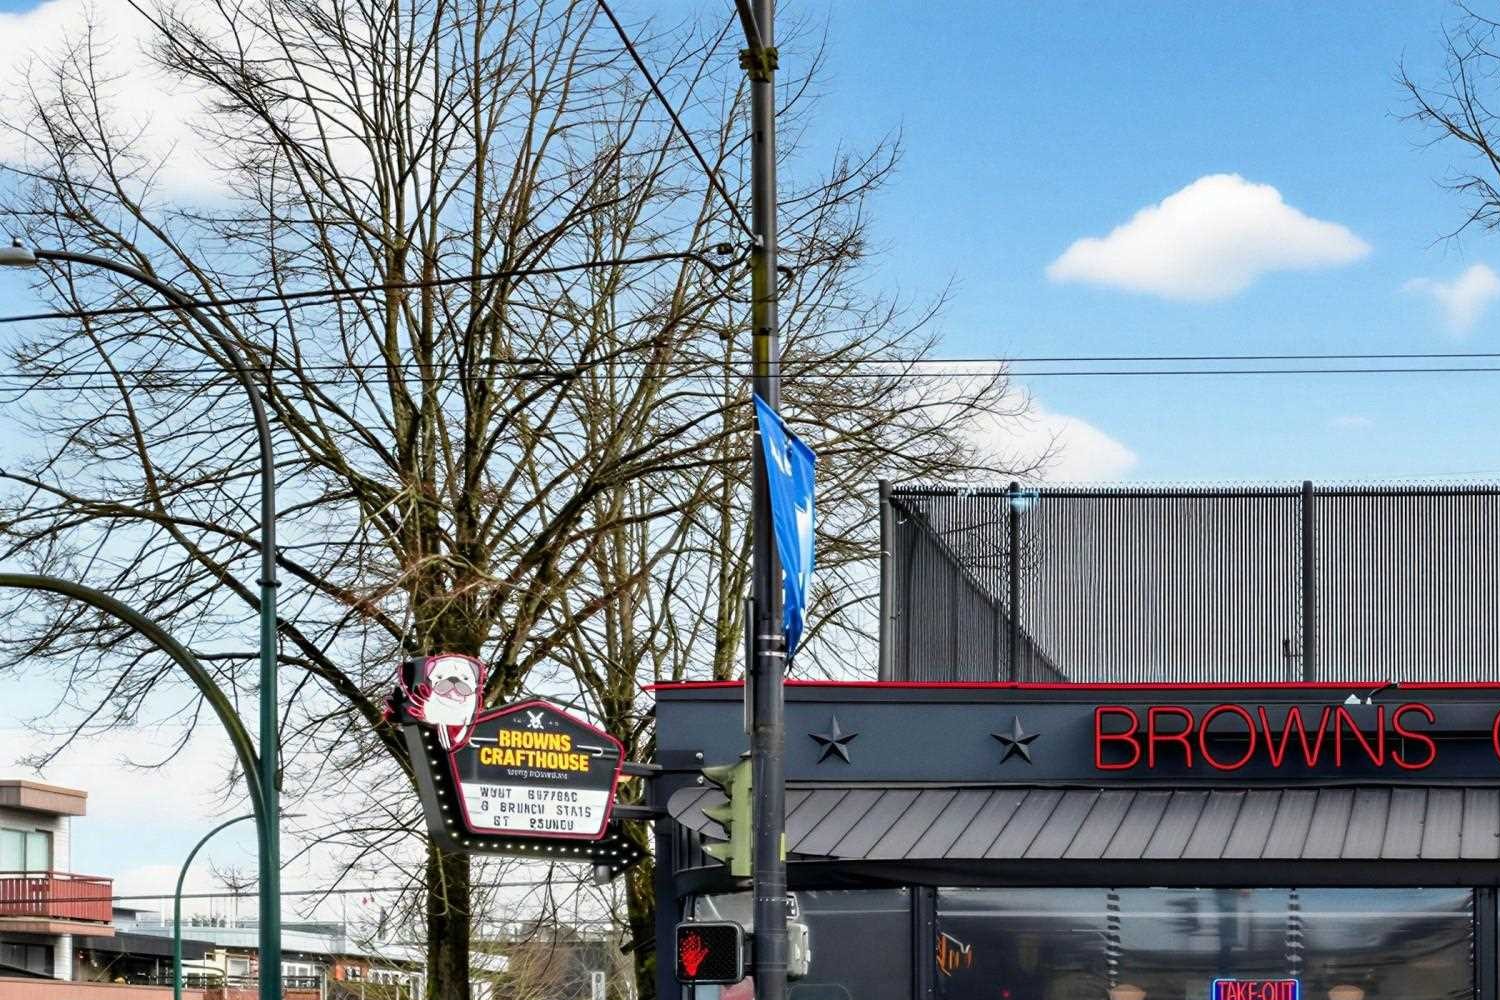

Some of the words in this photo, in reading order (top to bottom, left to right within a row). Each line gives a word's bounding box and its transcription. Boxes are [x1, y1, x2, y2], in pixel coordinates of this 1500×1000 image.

[499, 729, 572, 752] BROWNS
[1094, 702, 1438, 772] BROWNS
[480, 747, 590, 772] CRAFTHOUSE
